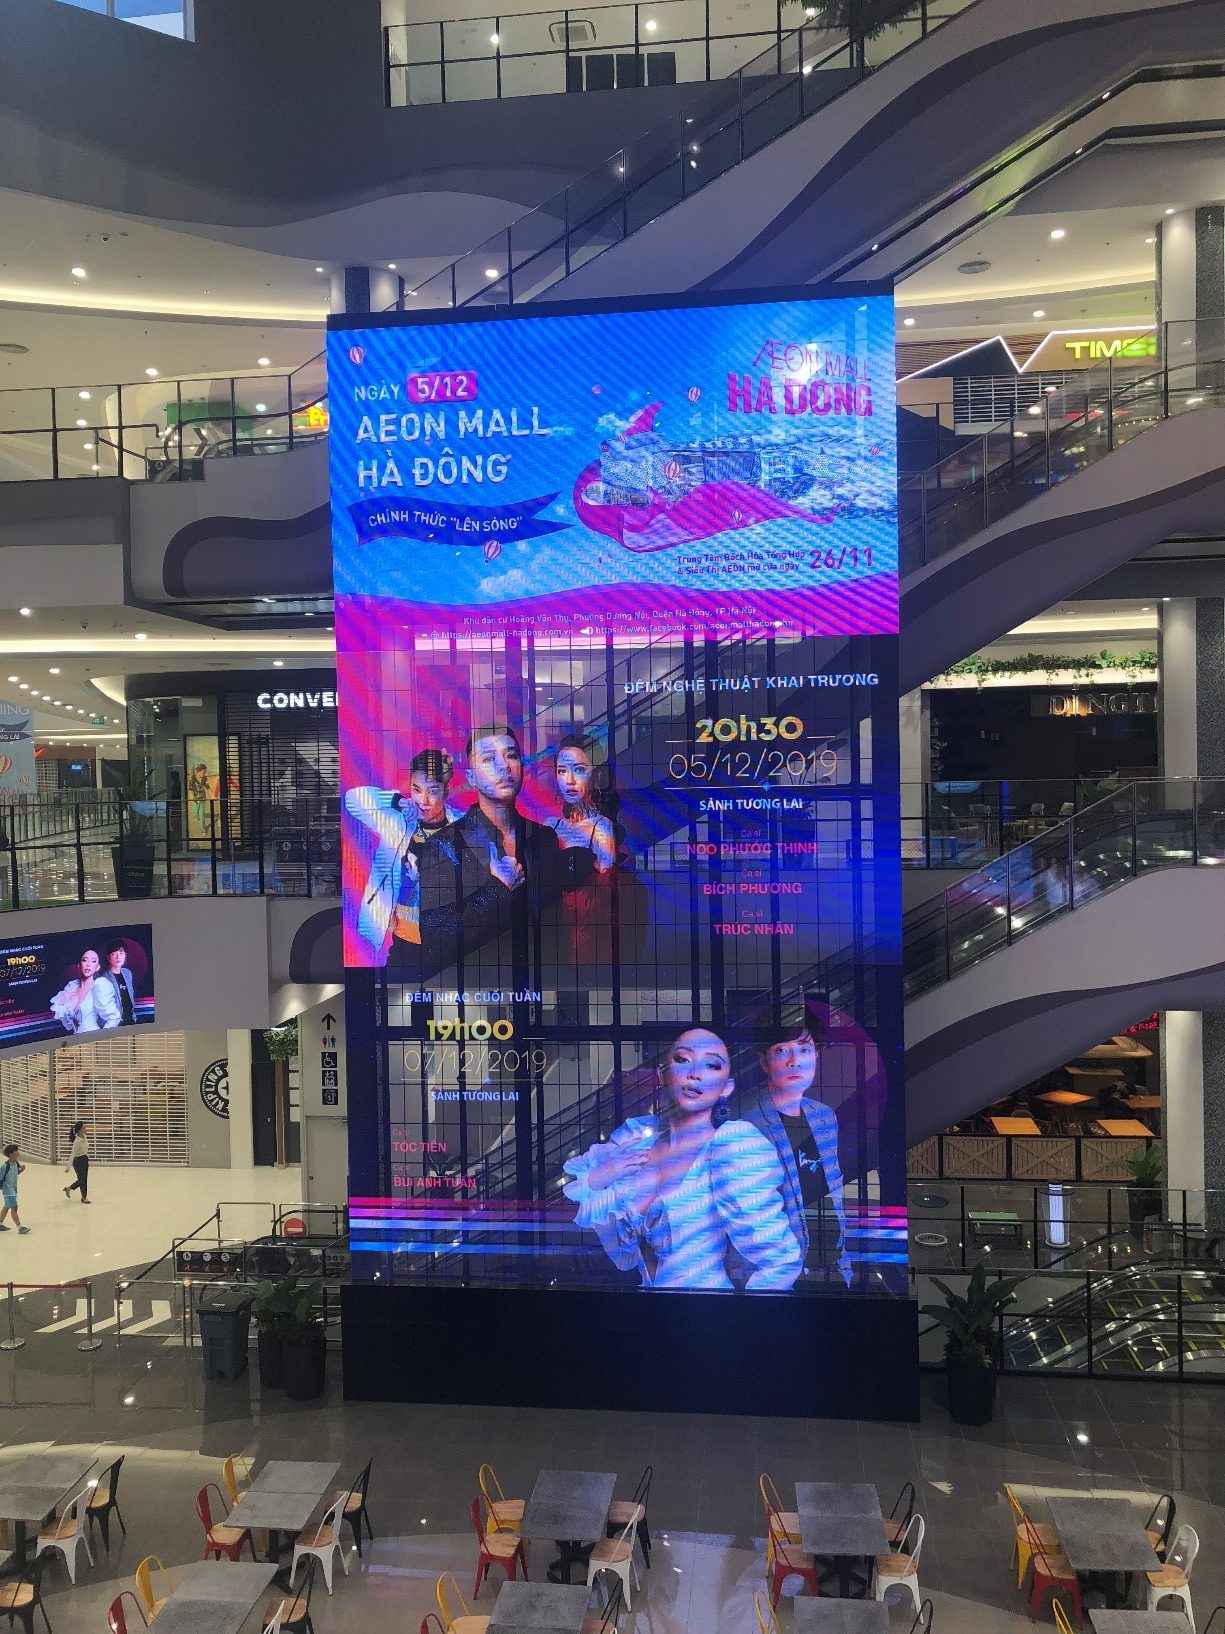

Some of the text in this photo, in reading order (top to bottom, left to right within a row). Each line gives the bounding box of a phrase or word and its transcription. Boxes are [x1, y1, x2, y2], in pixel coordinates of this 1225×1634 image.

[825, 351, 871, 382] MALL
[354, 375, 468, 401] NGÀY 5/12
[355, 410, 446, 443] AEON
[458, 406, 549, 439] MALL
[357, 446, 508, 488] HÀ ĐÔNG
[368, 509, 409, 527] CHÍNH
[413, 510, 447, 528] THỨC
[676, 555, 702, 565] Trung
[703, 553, 722, 563] Tâm
[724, 552, 745, 562] Bách
[766, 549, 787, 560] Tổng
[808, 546, 874, 570] 26/11
[676, 566, 684, 575] &
[705, 565, 720, 576] Thị
[721, 563, 746, 574] AEON
[463, 616, 480, 626] Khu
[509, 613, 535, 626] Hoàng
[662, 677, 706, 695] NGHỆ
[709, 675, 762, 693] THUẬT
[766, 674, 804, 690] KHAI
[807, 672, 879, 688] TRƯƠNG
[257, 692, 338, 709] CONVE
[695, 714, 804, 743] 20h30
[669, 748, 838, 781] 05/12/2019
[700, 797, 803, 811] SẢNH TƯƠNG LAI
[740, 830, 753, 838] Ca
[775, 841, 817, 857] THỊNH
[741, 869, 753, 877] Ca
[703, 880, 803, 895] BÍCH PHƯƠNG
[741, 910, 754, 918] Ca
[714, 920, 794, 936] TRÚC NHÂN
[405, 987, 541, 1005] ĐÊM NHẠC CUỐI TUẦN
[426, 1017, 514, 1041] 19h00
[404, 1047, 547, 1075] 07/12/2019
[205, 1066, 225, 1111] KIPLING
[431, 1089, 520, 1102] SẢNH TƯƠNG LAI
[416, 1177, 442, 1187] ANH
